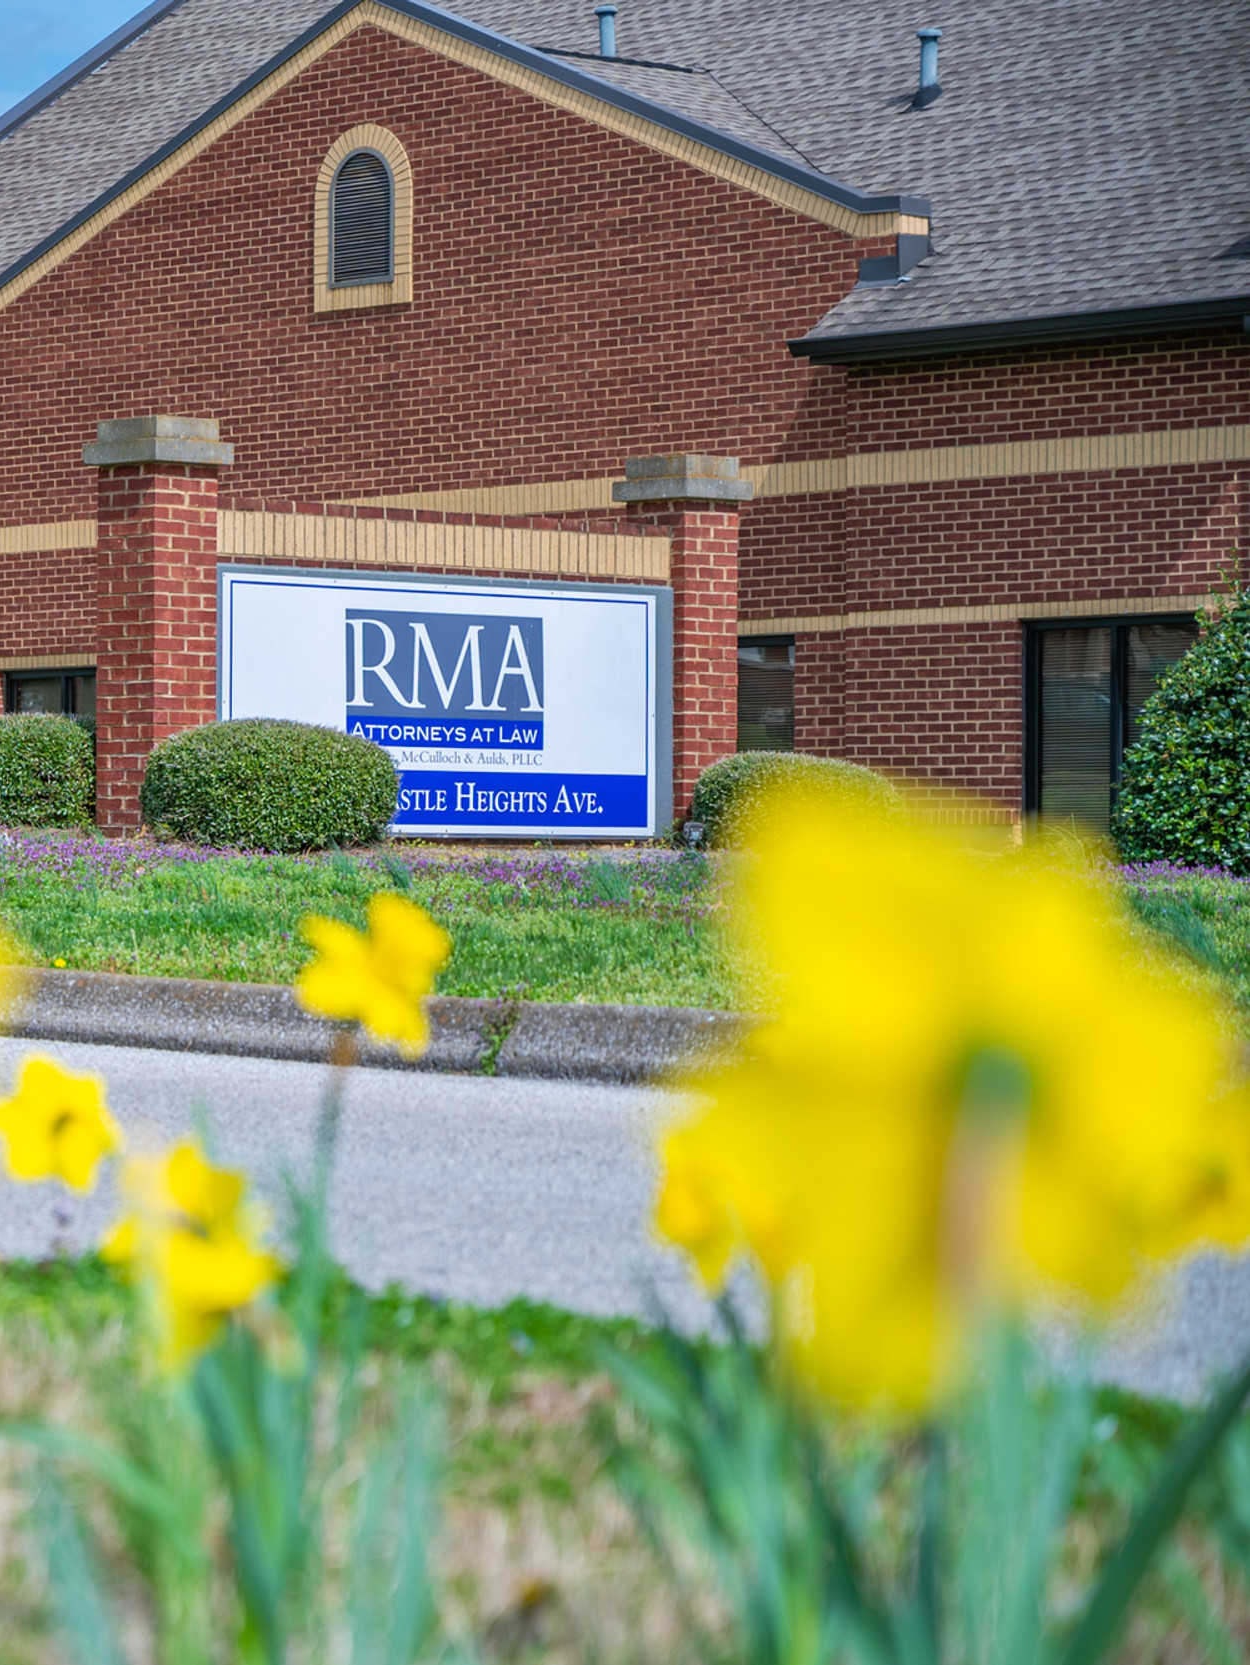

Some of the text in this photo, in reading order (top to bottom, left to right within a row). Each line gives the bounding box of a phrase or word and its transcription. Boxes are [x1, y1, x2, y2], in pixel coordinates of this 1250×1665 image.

[346, 618, 544, 712] RMA
[401, 750, 461, 764] McCulloch
[464, 752, 474, 764] &
[476, 752, 509, 766] Aulds,
[512, 753, 543, 766] PLLC
[395, 788, 447, 811] STLE
[454, 782, 547, 813] HEIGHTS
